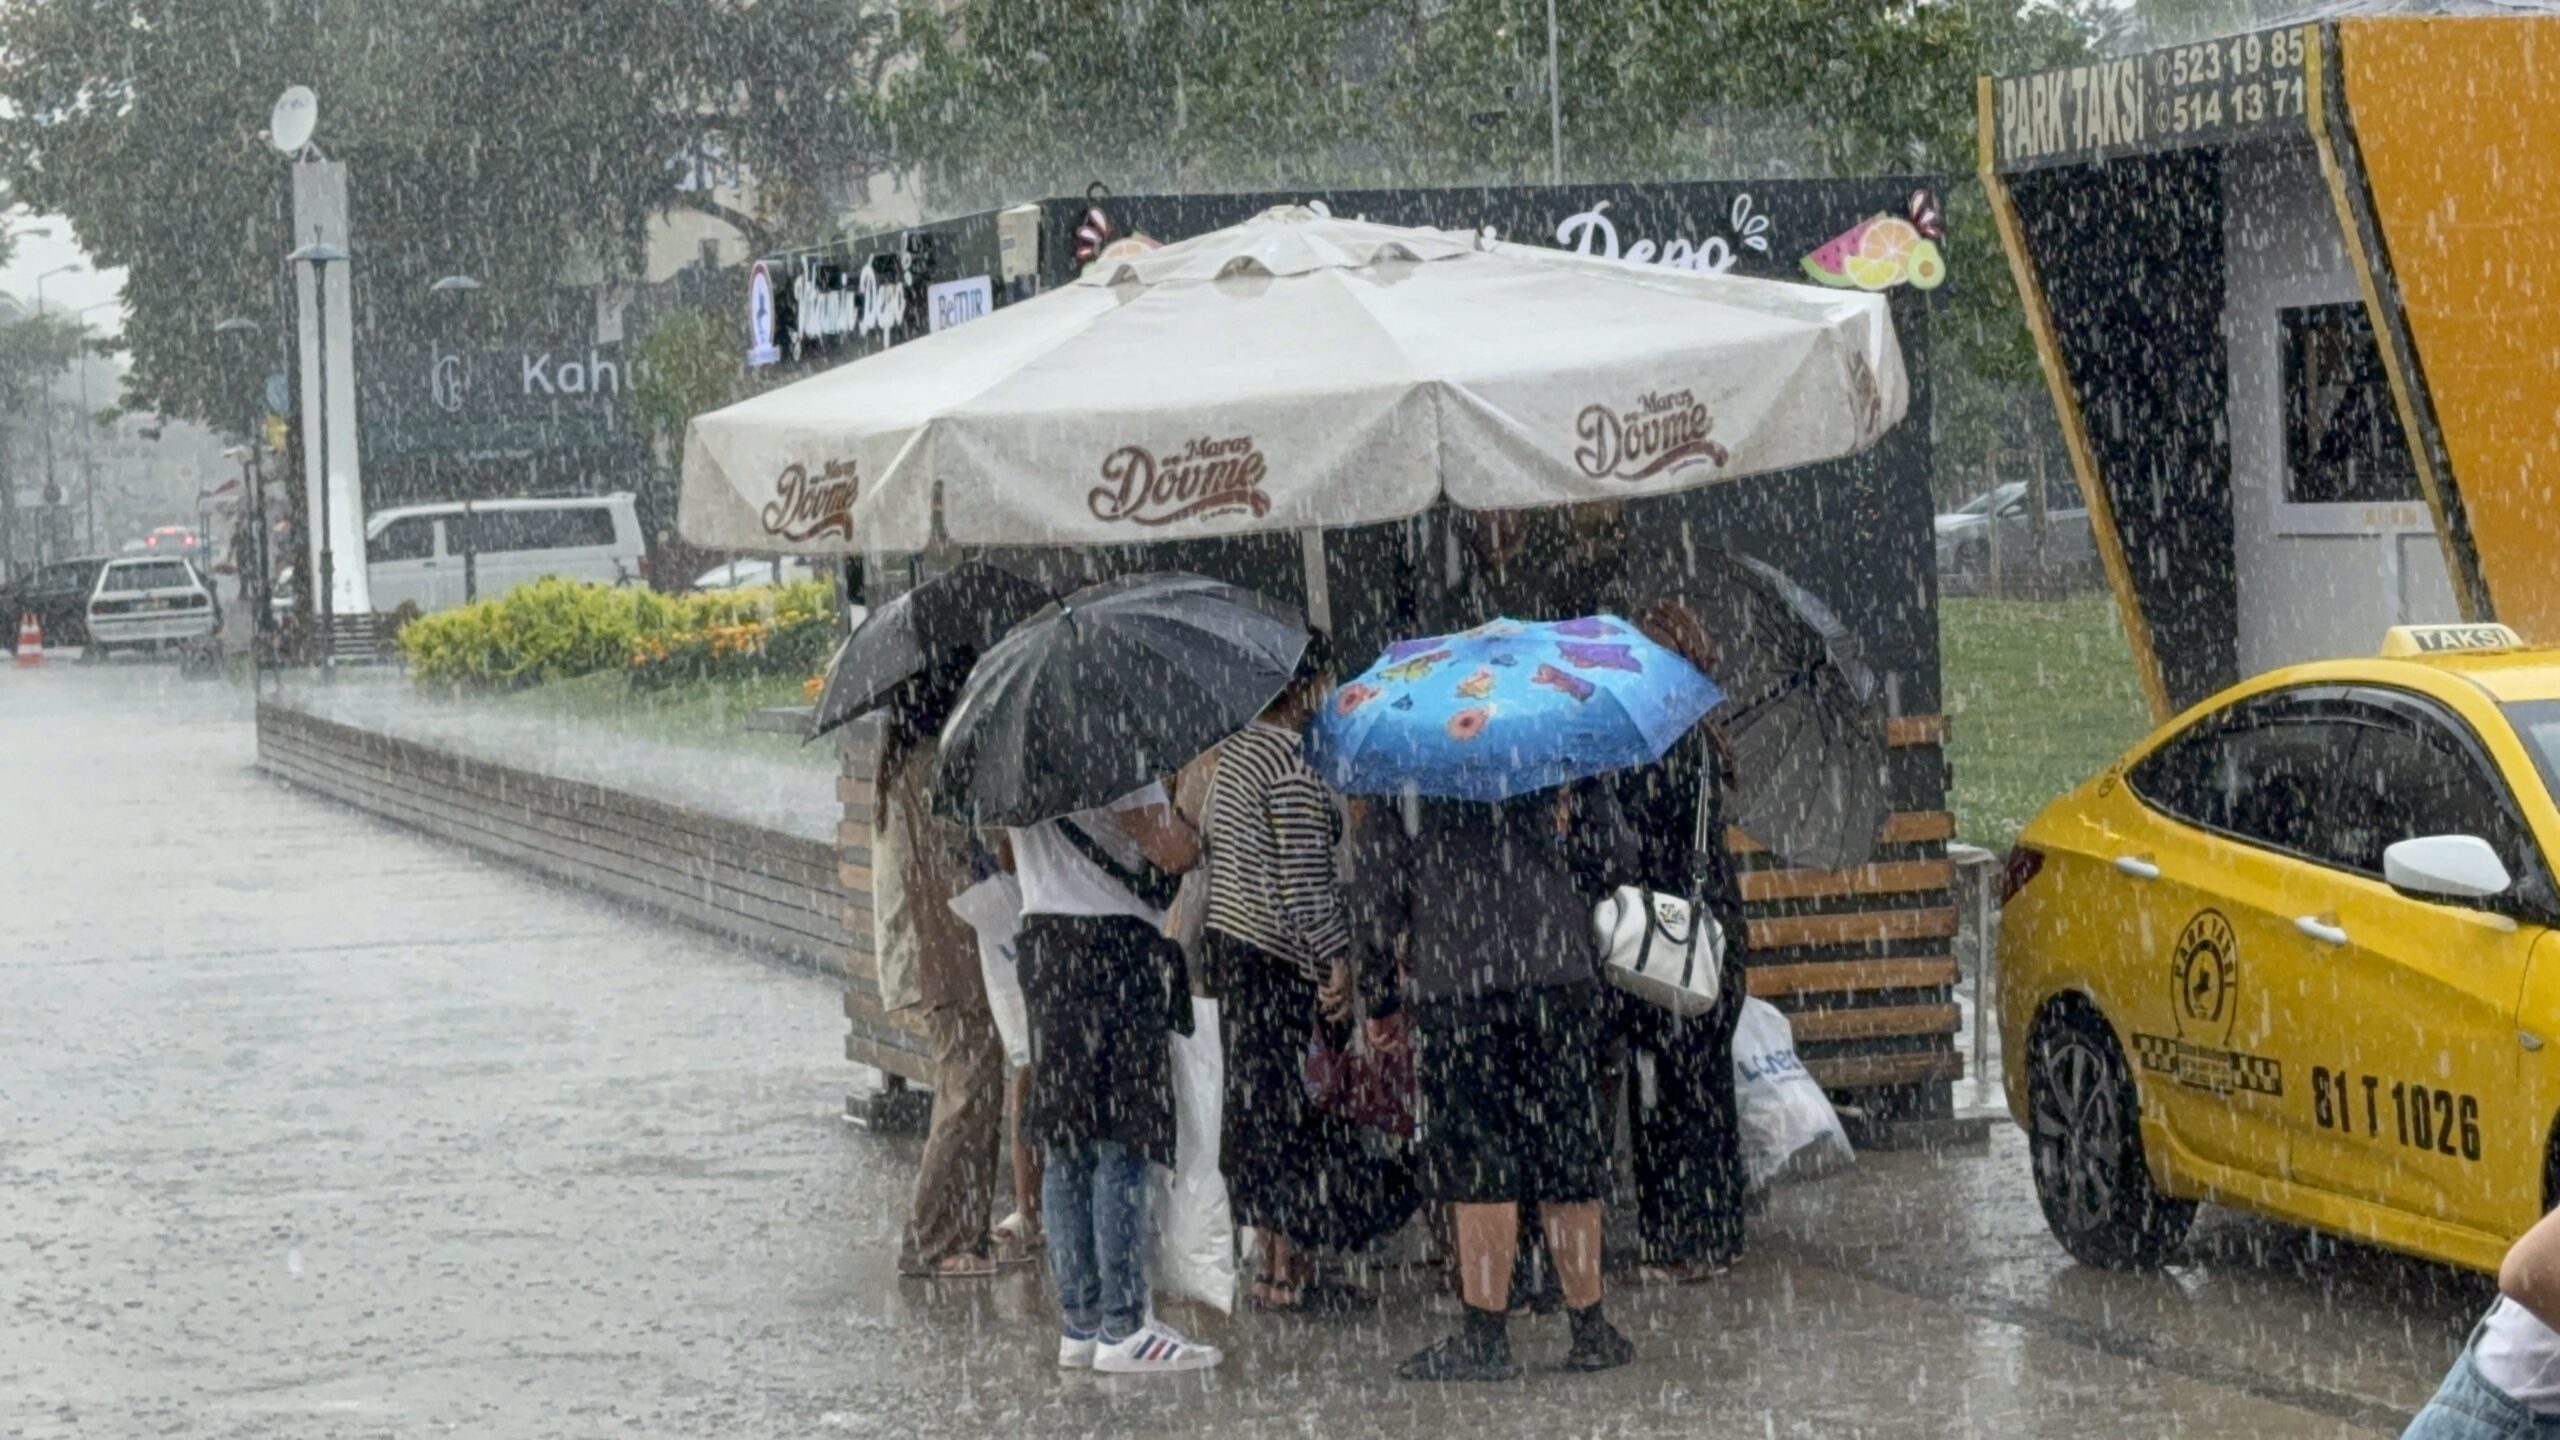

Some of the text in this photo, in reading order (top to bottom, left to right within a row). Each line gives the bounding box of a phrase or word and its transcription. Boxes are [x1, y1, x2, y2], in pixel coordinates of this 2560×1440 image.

[2172, 28, 2304, 87] 523 19 85
[2002, 69, 2066, 163] PARK
[2172, 76, 2304, 133] 514 13 71
[2312, 1066, 2351, 1134] 81
[2361, 1074, 2379, 1139] T
[2392, 1080, 2483, 1163] 1026
